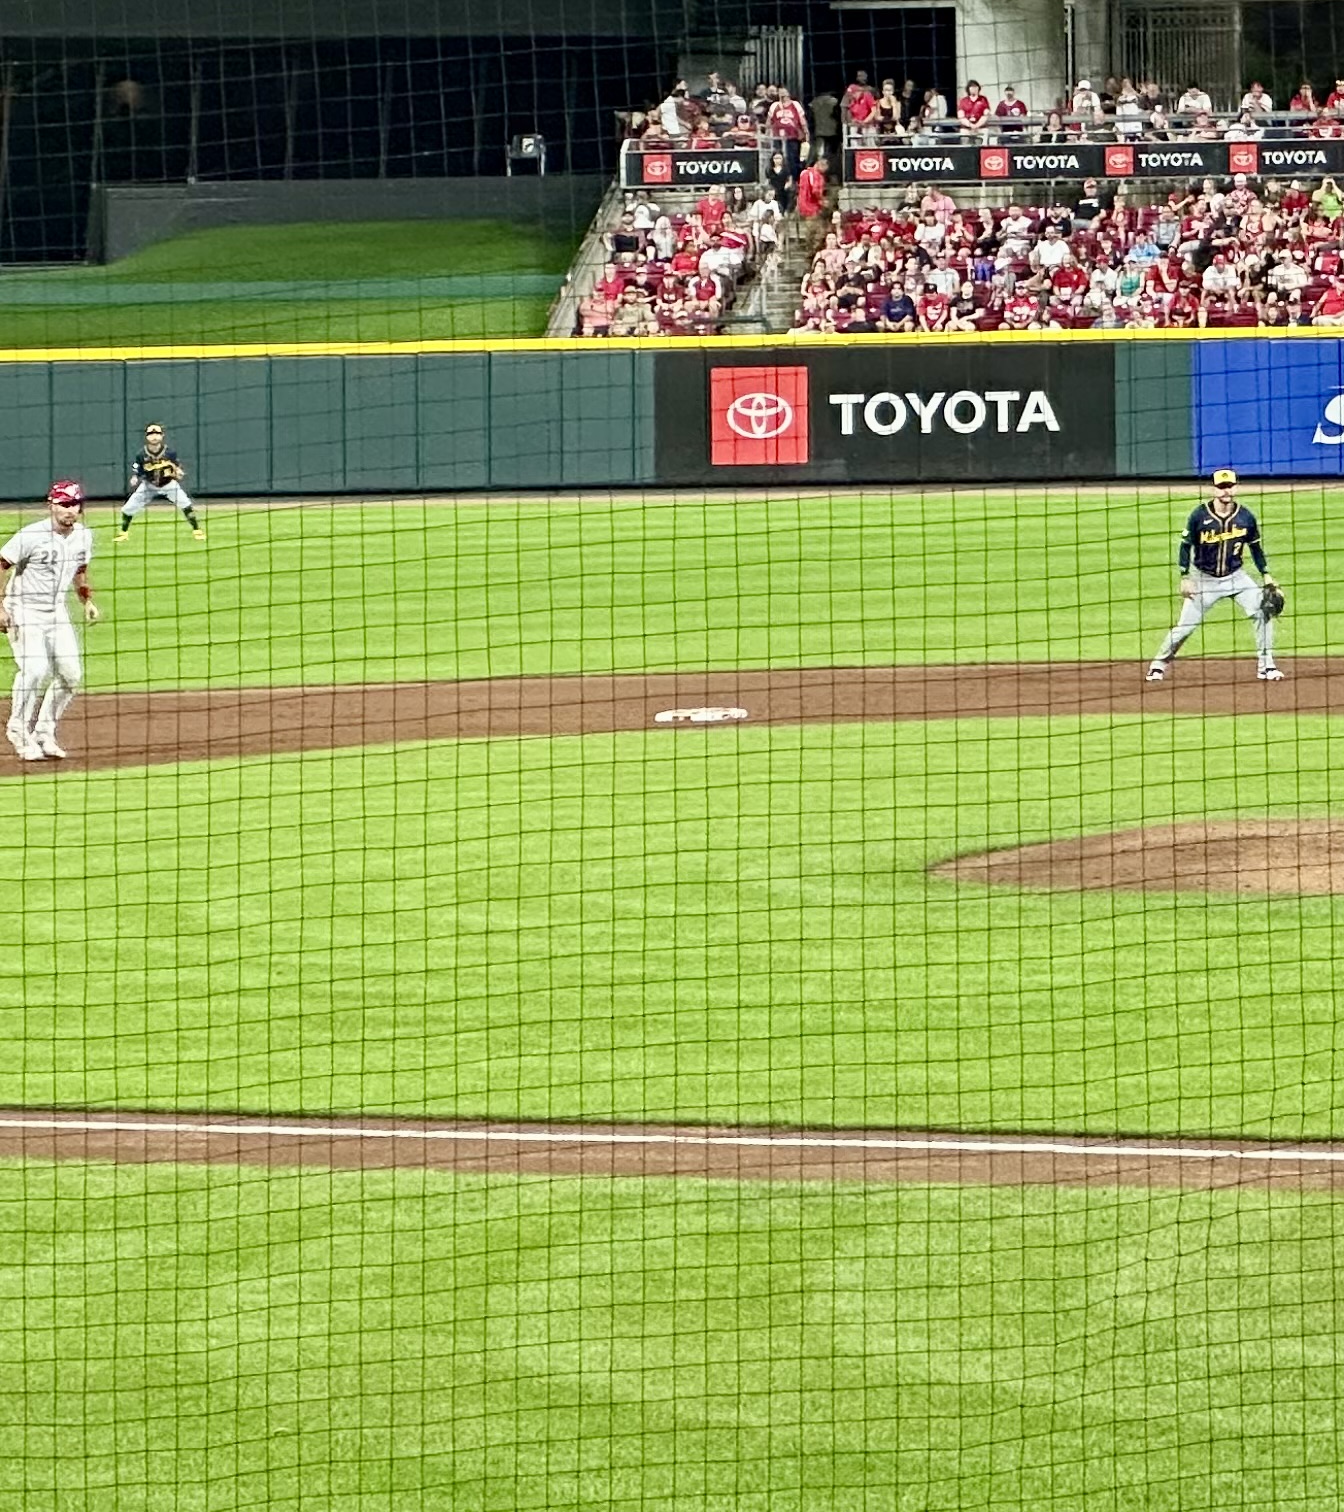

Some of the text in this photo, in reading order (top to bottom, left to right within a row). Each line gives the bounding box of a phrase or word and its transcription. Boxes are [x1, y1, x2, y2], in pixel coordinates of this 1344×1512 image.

[889, 157, 955, 172] TOYOTA
[1013, 154, 1079, 170] TOYOTA
[1138, 151, 1204, 167] TOYOTA
[1262, 149, 1327, 165] TOYOTA
[676, 159, 743, 176] TOYOTA
[828, 390, 1061, 436] TOYOTA
